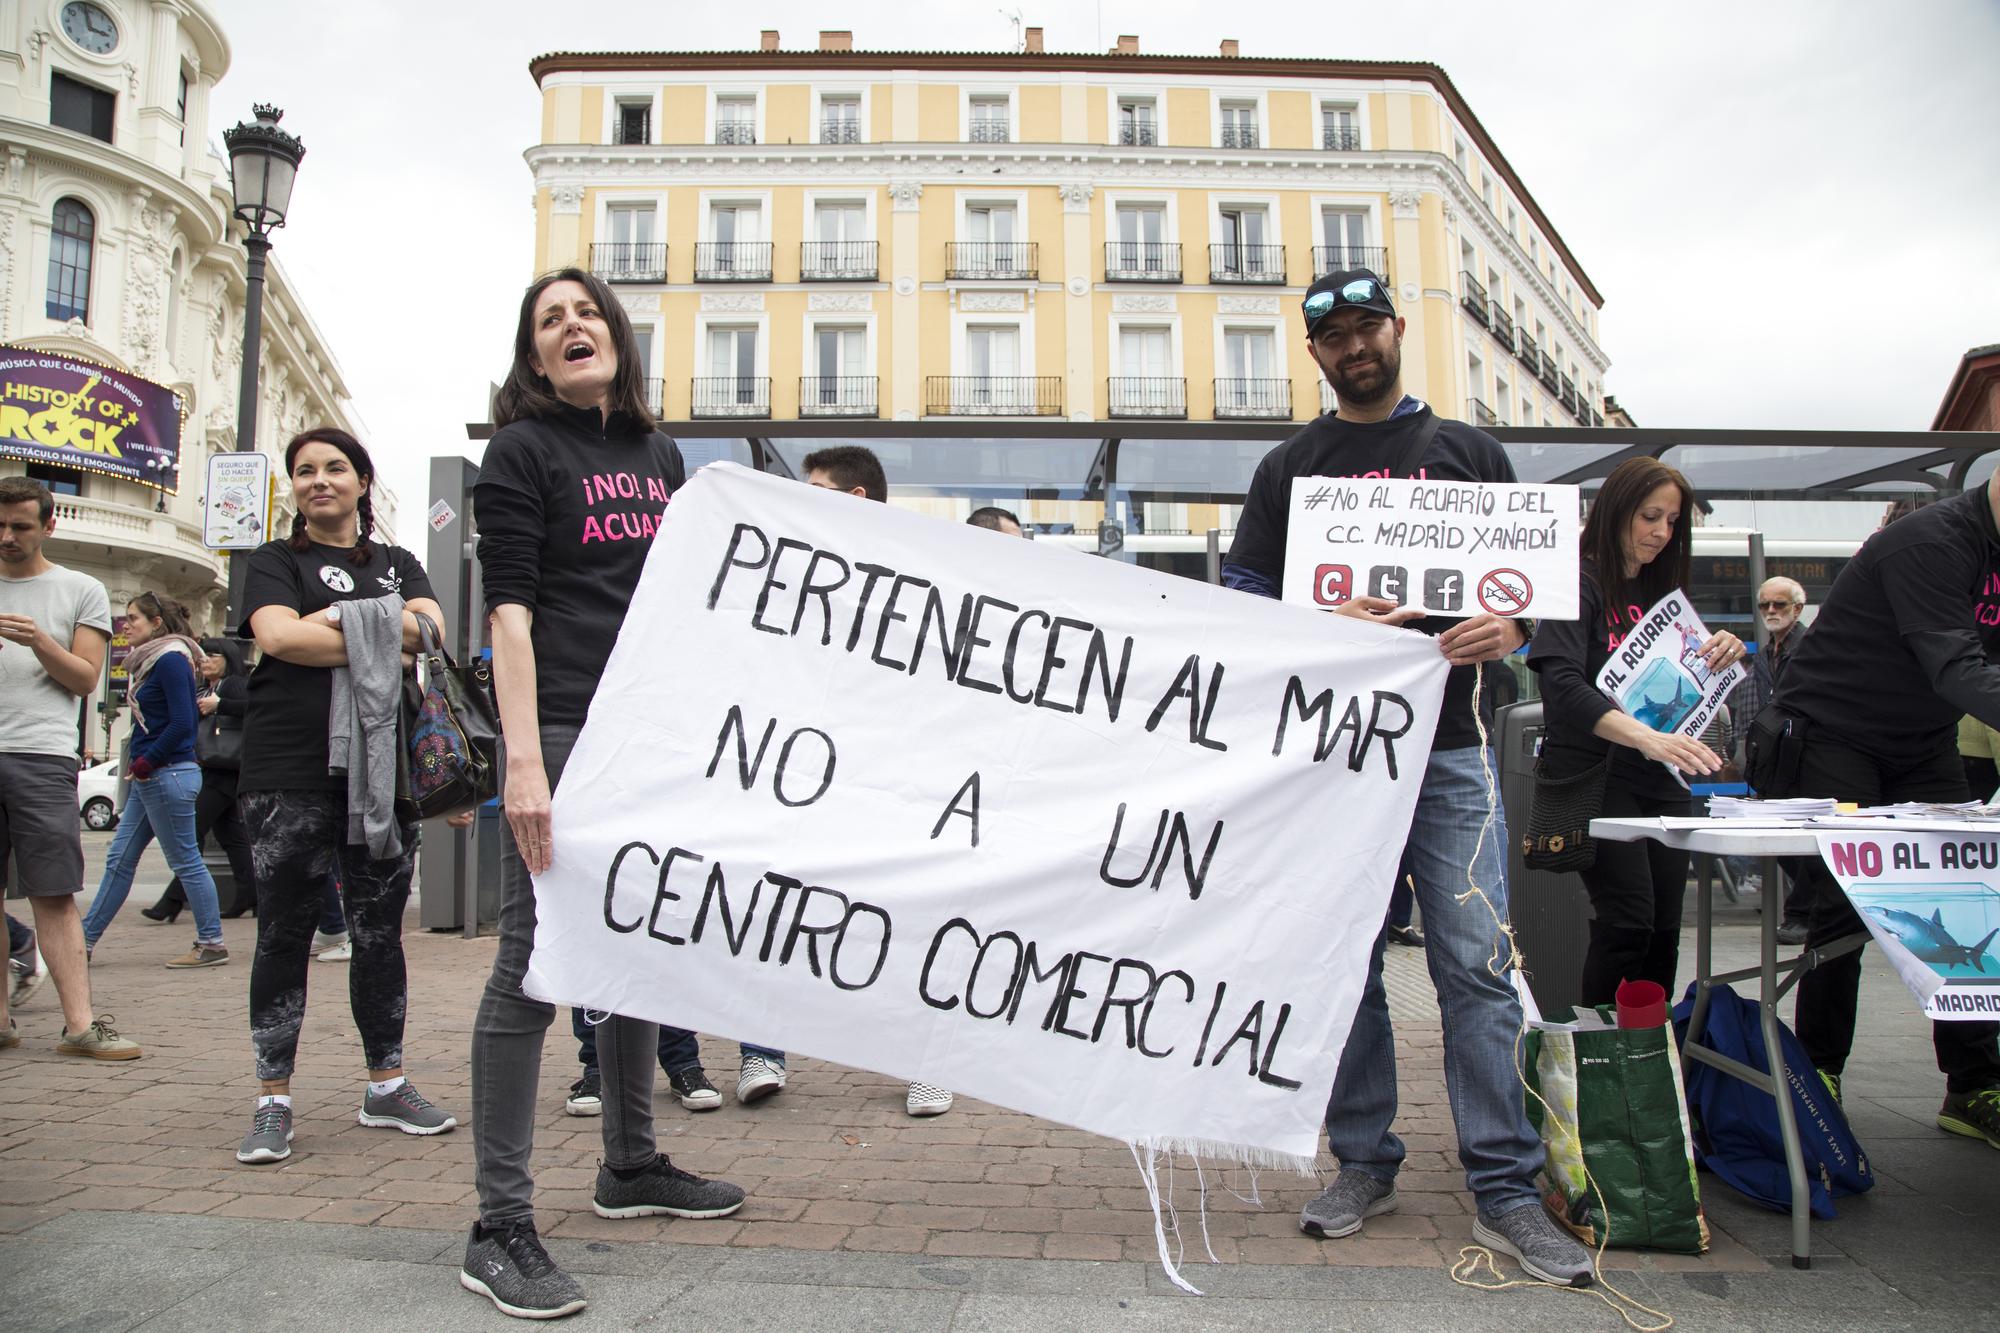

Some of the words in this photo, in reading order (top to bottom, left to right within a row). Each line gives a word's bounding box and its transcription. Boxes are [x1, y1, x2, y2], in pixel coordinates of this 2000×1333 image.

[6, 382, 95, 412] HISTORY
[98, 401, 124, 419] OF
[39, 360, 61, 369] QUE
[103, 375, 112, 386] EL
[113, 380, 143, 408] MUNDO
[0, 405, 122, 458] ROCK
[131, 442, 145, 451] VIVE
[62, 453, 82, 464] MÁS
[83, 458, 141, 477] EMOCIONANTE
[582, 472, 643, 506] ¡NO!
[646, 477, 672, 503] AL
[1368, 486, 1394, 508] AL
[1507, 491, 1554, 514] DEL
[1468, 518, 1559, 554] XANADÚ
[707, 523, 1134, 723] PERTENECEN
[1145, 654, 1227, 751] AL
[1272, 675, 1413, 780] MAR
[1604, 669, 1627, 693] AL
[1621, 600, 1682, 670] ACUARIO
[1683, 711, 1707, 737] DRID
[1705, 668, 1737, 713] XANADÚ
[706, 705, 837, 807] NO
[931, 771, 980, 847] A
[1100, 803, 1223, 900] UN
[1831, 842, 1883, 877] NO
[1893, 842, 1930, 870] AL
[1940, 842, 1999, 870] ACU
[604, 841, 893, 990] CENTRO
[919, 917, 1303, 1092] COMERCIAL
[1784, 1063, 1819, 1117] IMPRESSIO
[1827, 1135, 1848, 1167] LEAVE
